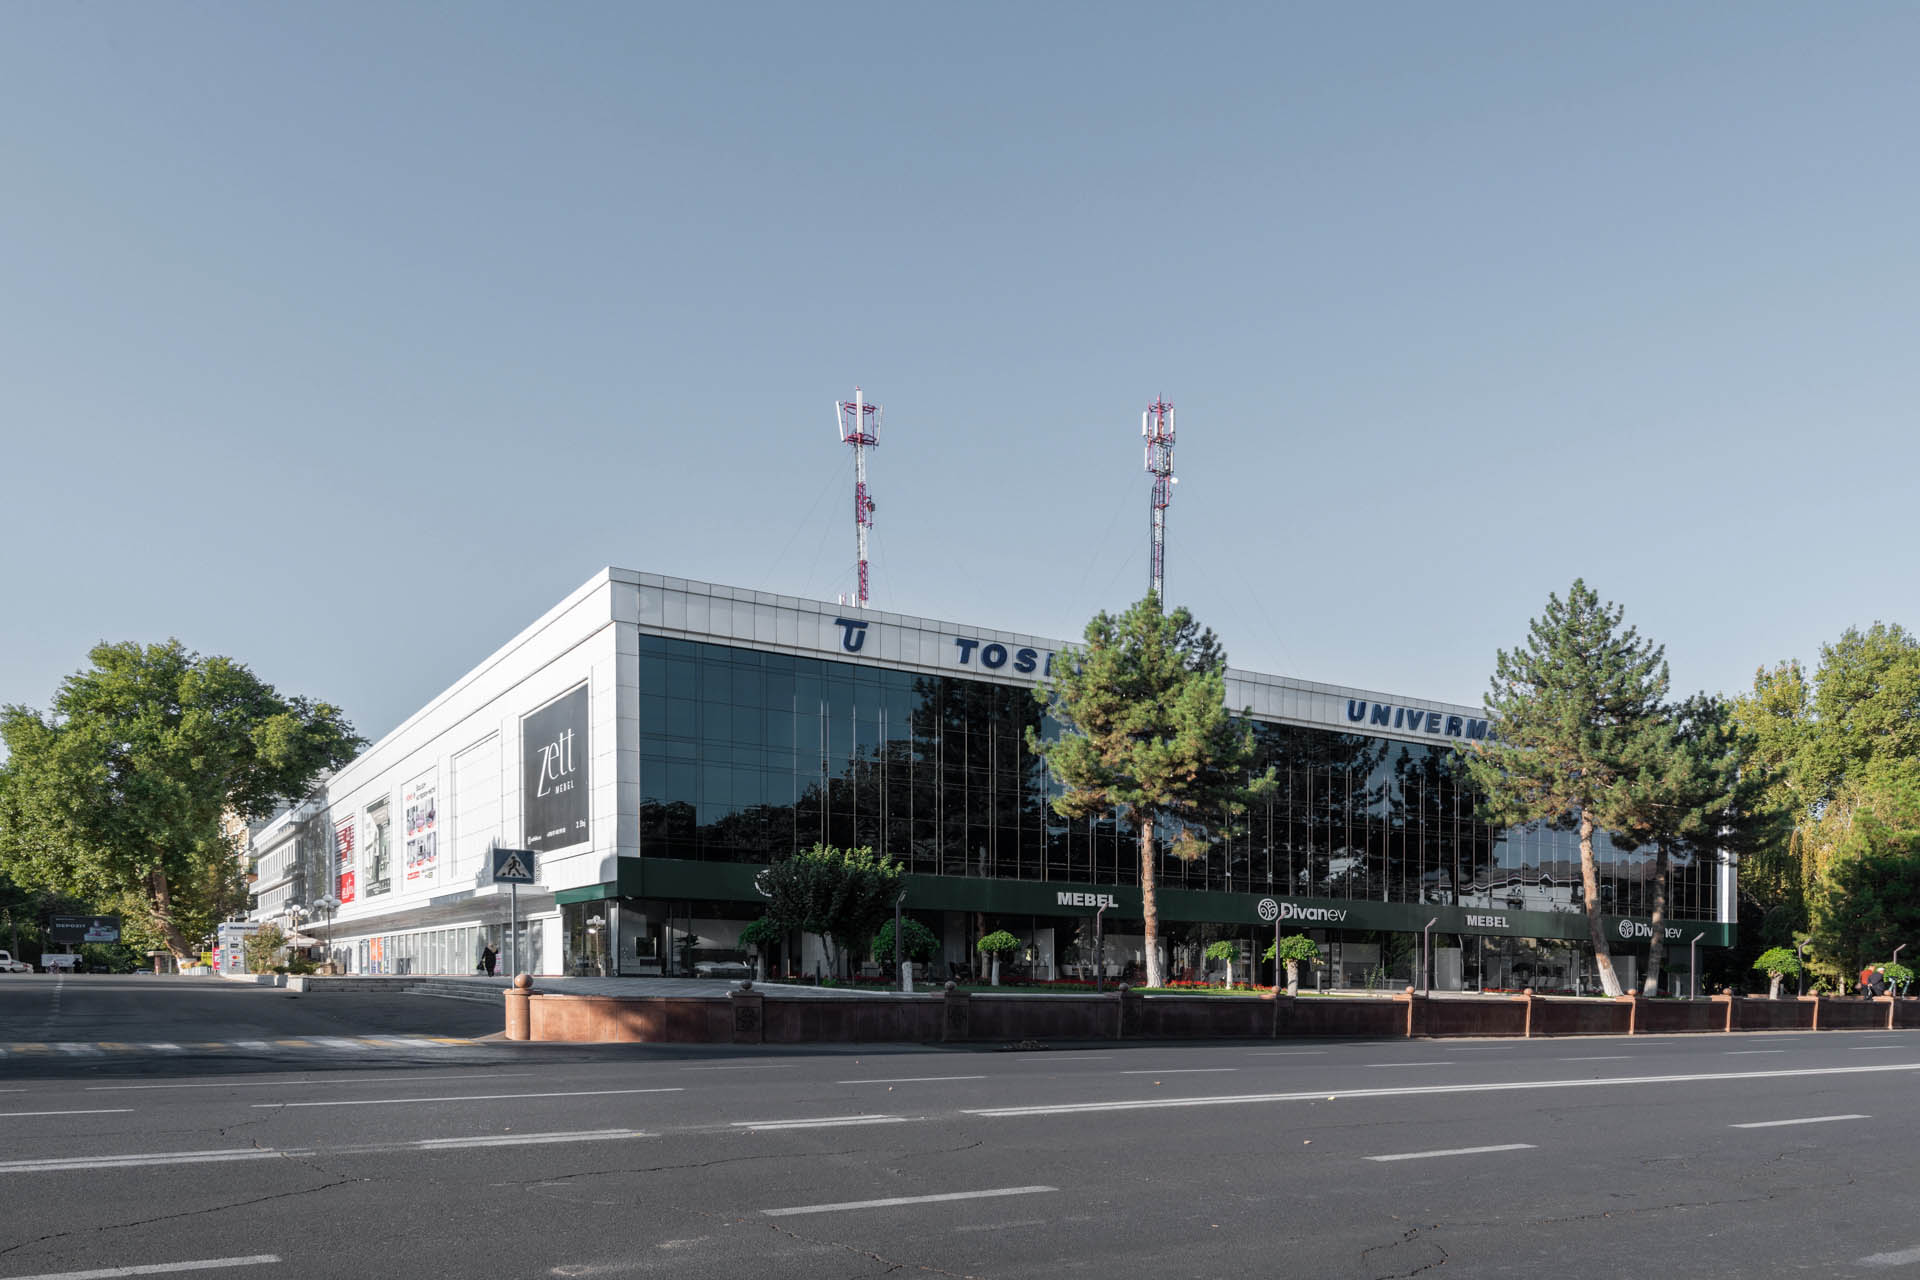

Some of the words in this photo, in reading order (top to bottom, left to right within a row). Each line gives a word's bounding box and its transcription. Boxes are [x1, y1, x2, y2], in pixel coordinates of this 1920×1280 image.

[1057, 892, 1119, 908] MEBEL
[1280, 902, 1347, 922] Divanev
[1466, 914, 1509, 928] MEBEL
[1634, 922, 1682, 939] Divnev
